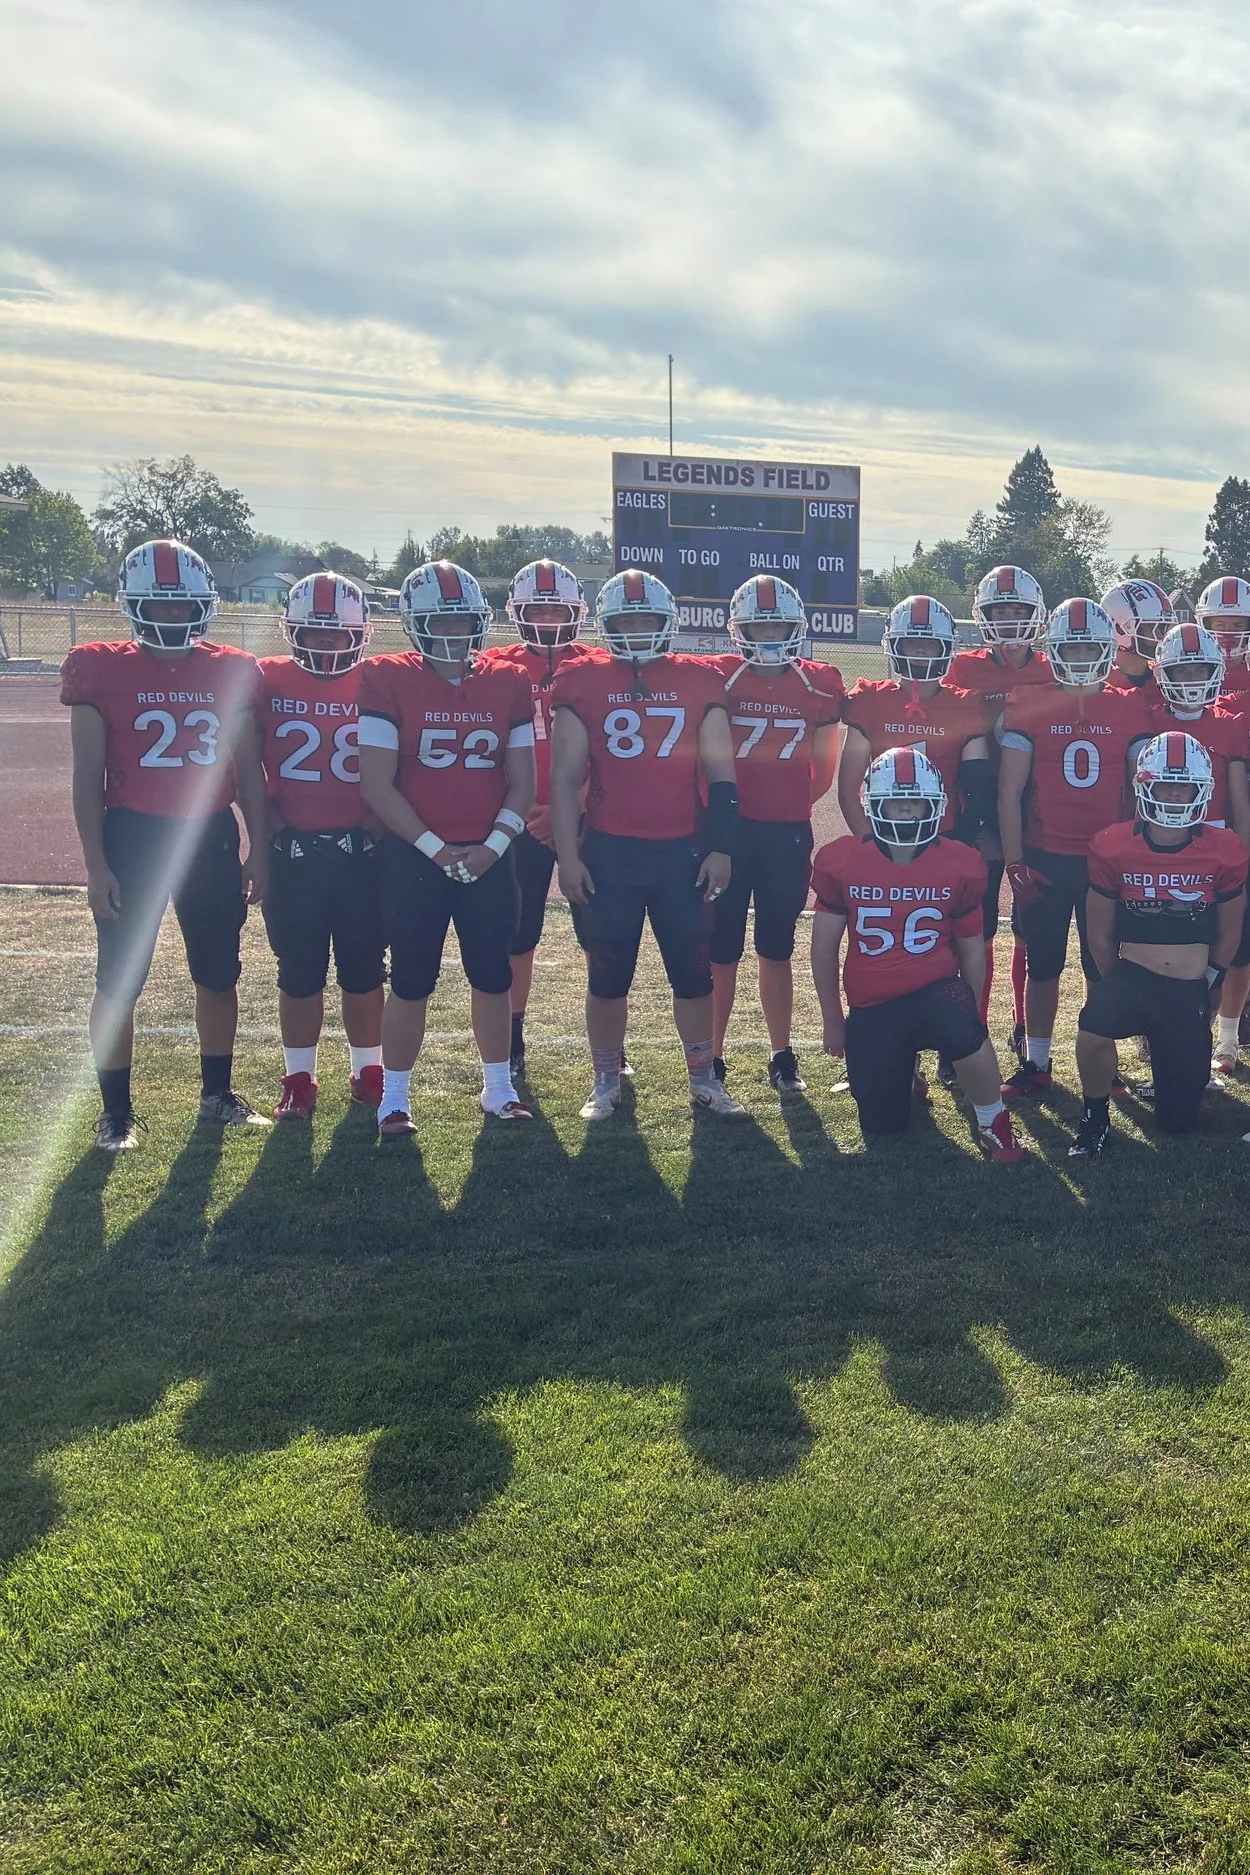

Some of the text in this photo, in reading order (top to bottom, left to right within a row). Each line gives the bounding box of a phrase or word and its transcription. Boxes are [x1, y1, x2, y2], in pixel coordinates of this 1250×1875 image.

[643, 461, 830, 491] LEGENDS FIELD
[617, 492, 666, 509] EAGLES
[808, 502, 854, 519] GUEST
[621, 546, 664, 562] DOWN
[679, 550, 720, 566] TO GO
[750, 553, 800, 570] BALL ON
[818, 556, 844, 572] QTR
[812, 612, 854, 634] CLUB
[138, 692, 214, 703] RED DEVILS
[608, 693, 631, 703] RED
[272, 698, 358, 716] RED DEVI
[740, 702, 761, 712] RED
[425, 712, 493, 723] RED DEVILS
[603, 707, 686, 759] 87
[731, 716, 806, 760] 77
[884, 724, 945, 736] RED DEVILS
[1050, 726, 1072, 734] RED
[134, 710, 220, 768] 23
[276, 720, 360, 783] 28
[416, 728, 500, 769] 52
[1062, 739, 1100, 788] 0
[1122, 873, 1214, 887] RED DEVILS
[850, 886, 951, 901] RED DEVILS
[856, 906, 944, 955] 56
